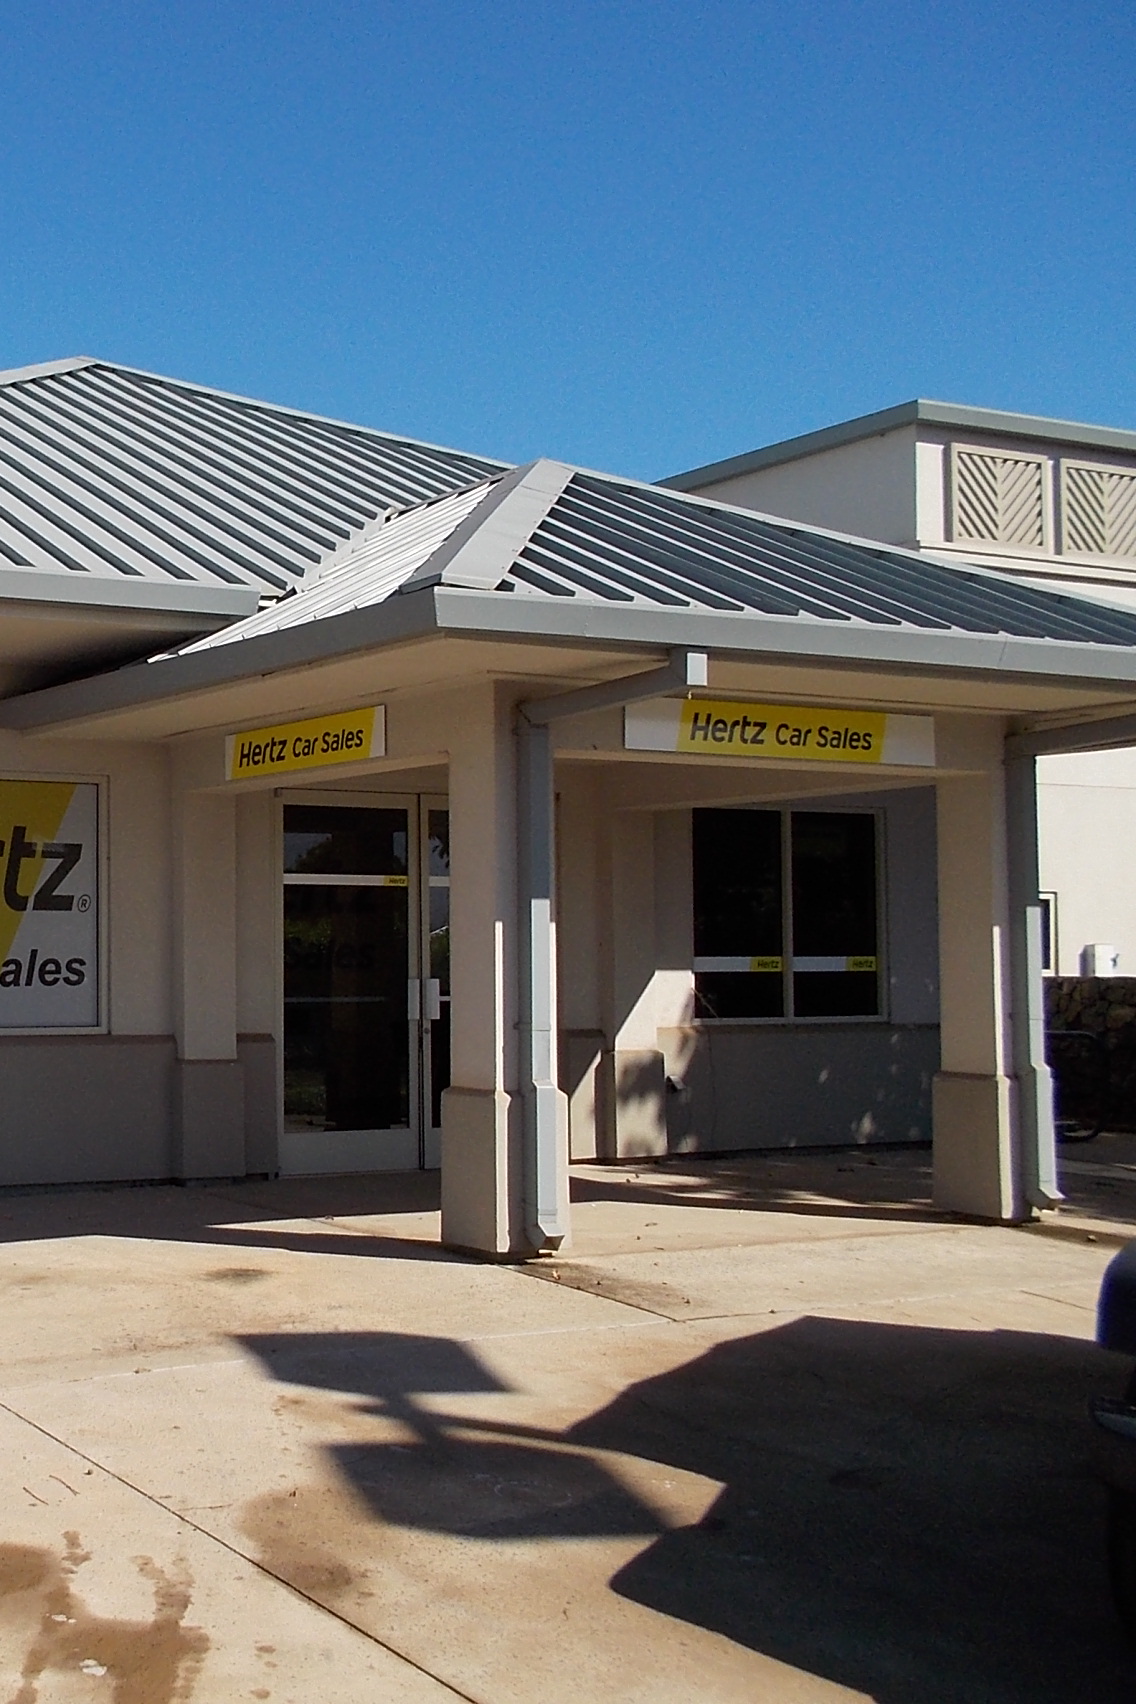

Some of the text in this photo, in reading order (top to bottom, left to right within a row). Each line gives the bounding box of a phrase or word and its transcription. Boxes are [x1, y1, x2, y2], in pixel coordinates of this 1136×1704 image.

[688, 712, 873, 751] Hertz Car Sales
[239, 728, 364, 768] Hertz Car Sales
[757, 959, 780, 969] Hertz
[852, 958, 873, 969] Hertz
